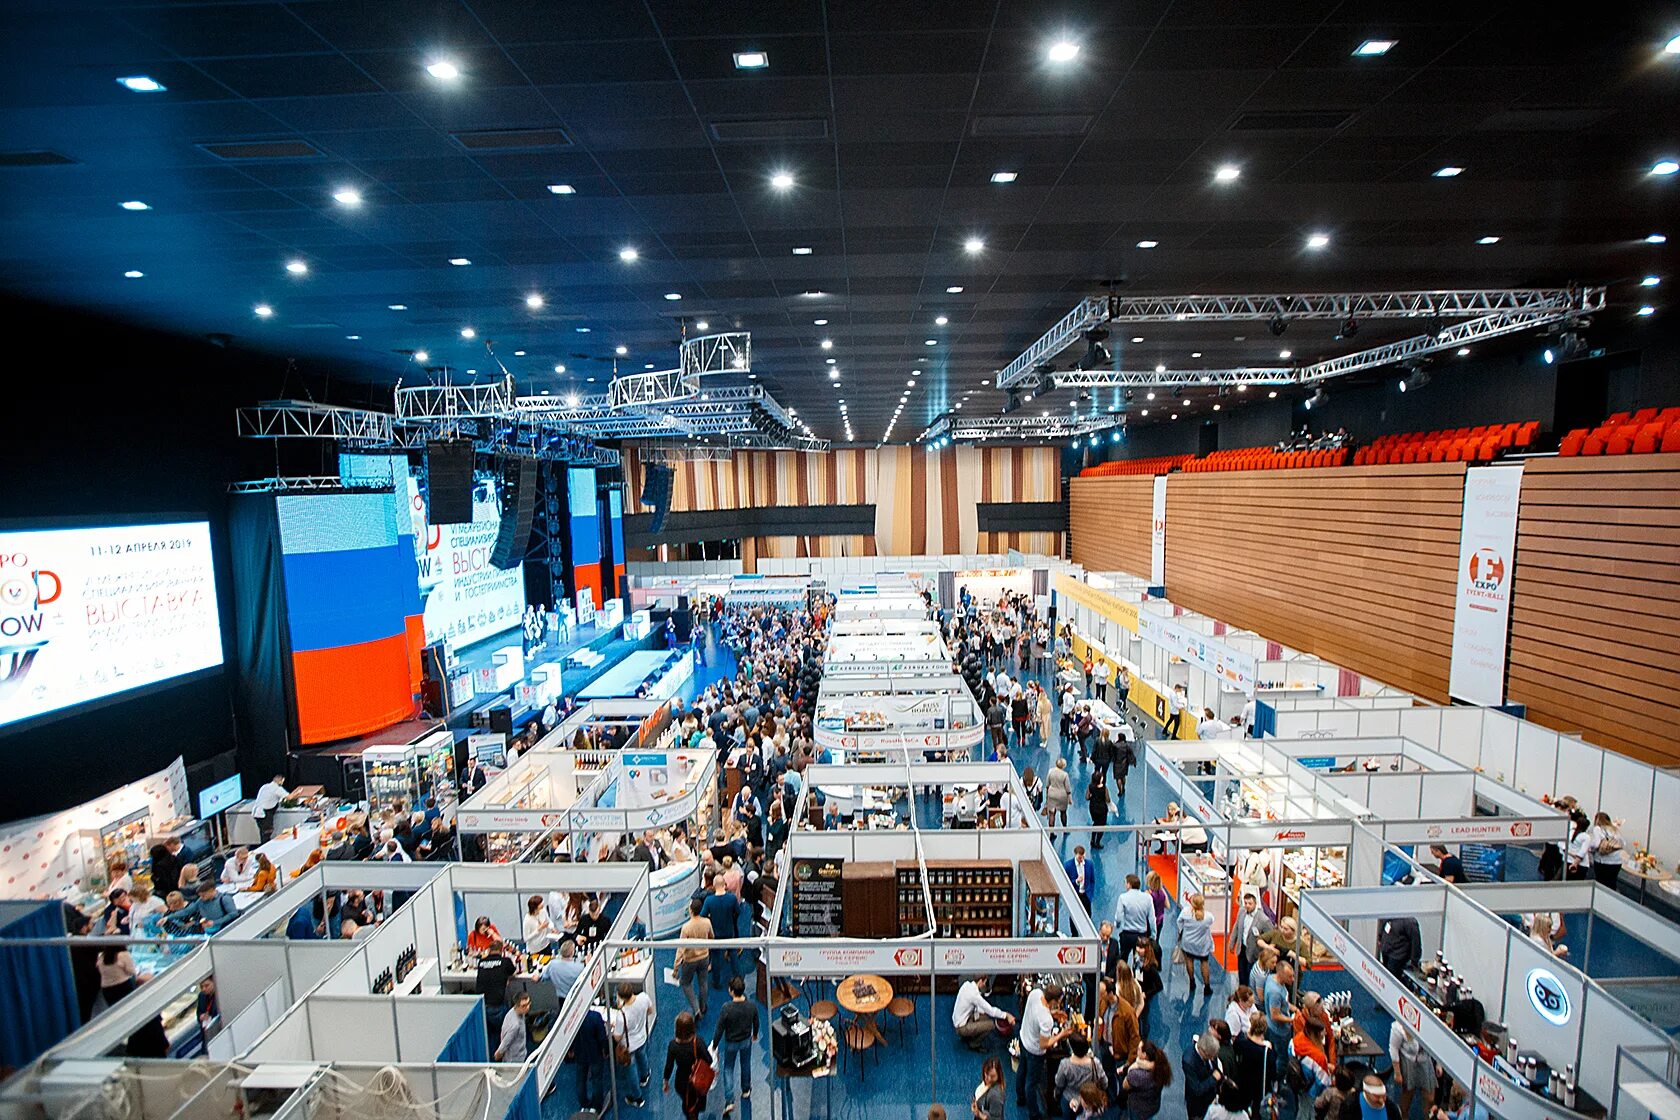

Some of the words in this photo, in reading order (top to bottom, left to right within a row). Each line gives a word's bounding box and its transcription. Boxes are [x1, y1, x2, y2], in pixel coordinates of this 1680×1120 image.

[90, 544, 123, 556] 11-12
[126, 541, 167, 554] АПРЕЛЯ
[1475, 581, 1498, 591] EXPO
